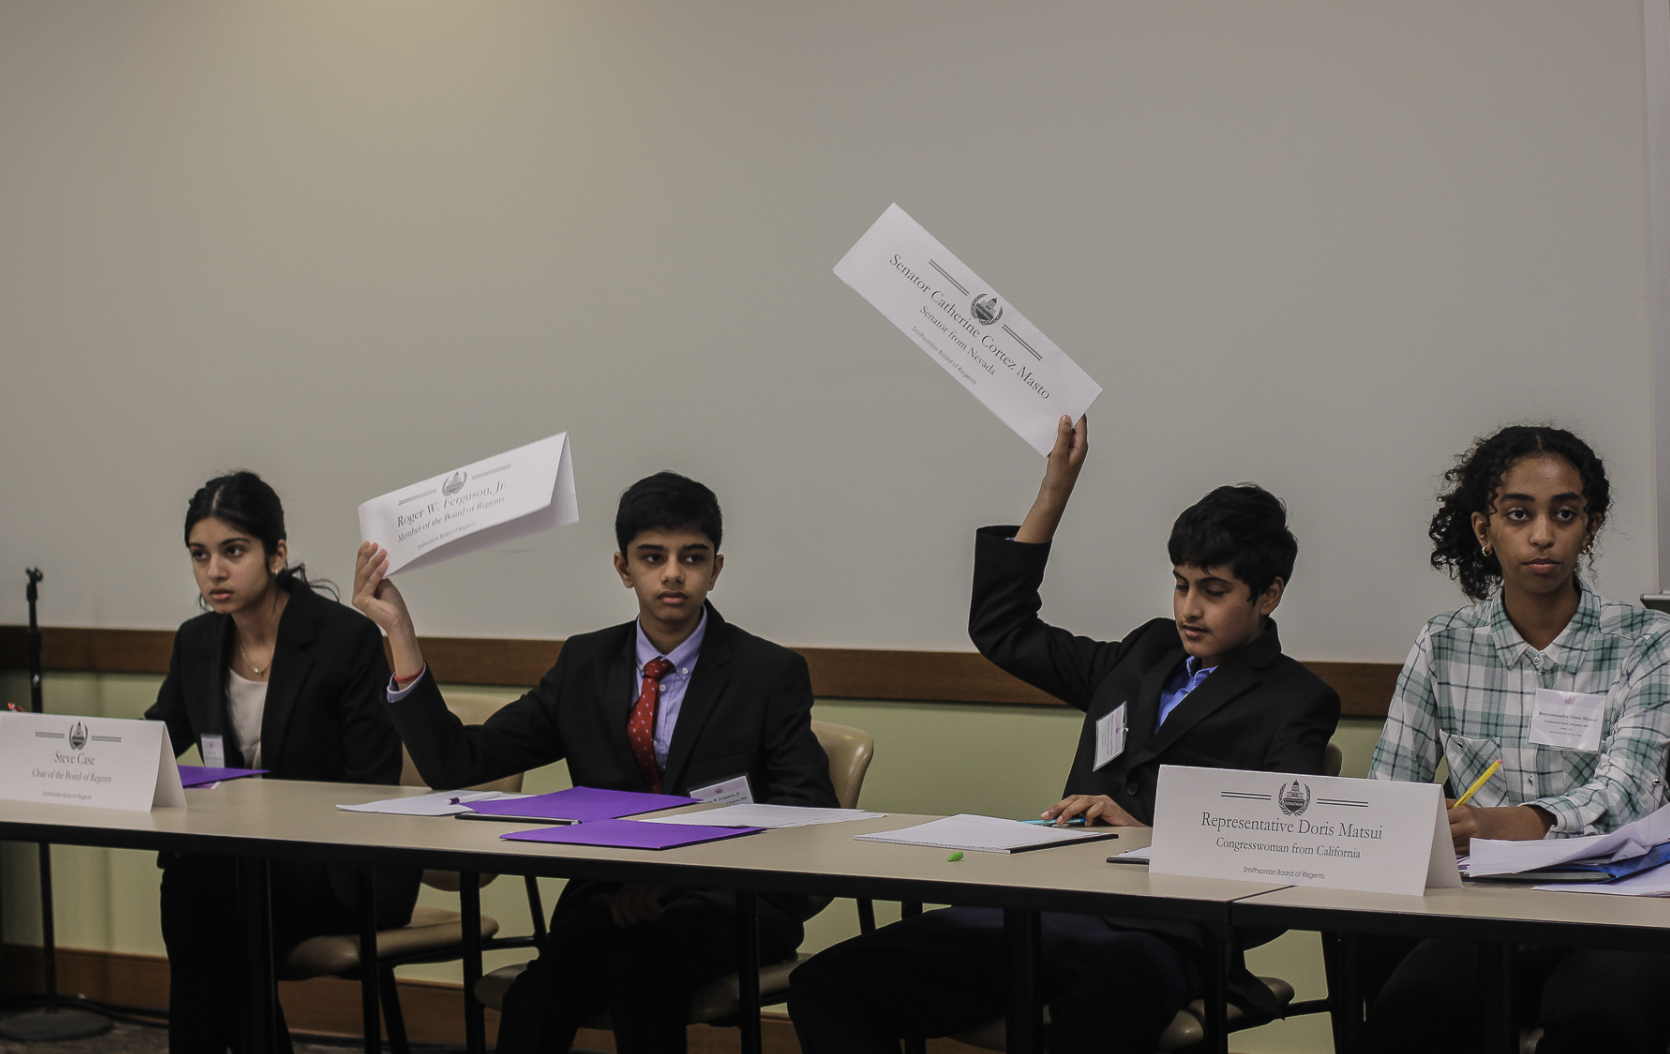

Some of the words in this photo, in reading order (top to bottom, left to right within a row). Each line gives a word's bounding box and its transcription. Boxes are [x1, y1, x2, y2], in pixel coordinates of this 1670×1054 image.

[889, 253, 931, 294] Senator
[931, 290, 980, 338] Catherine
[981, 335, 1016, 371] Cortez
[1017, 366, 1050, 400] Masto
[920, 305, 948, 334] Senator
[948, 330, 967, 351] from
[967, 346, 996, 375] Nevada
[912, 326, 940, 352] Smithsonian
[938, 349, 954, 364] Board
[951, 361, 959, 369] of
[957, 366, 977, 385] Regents
[397, 508, 424, 527] Roger
[427, 502, 438, 514] W.
[443, 488, 492, 508] Ferguson,
[495, 482, 507, 495] Jr.
[398, 526, 422, 542] Member
[423, 522, 431, 531] of
[432, 516, 442, 525] the
[444, 511, 465, 522] Board
[477, 497, 505, 510] Regents
[54, 751, 75, 764] Steve
[77, 752, 95, 765] Case
[32, 769, 47, 778] Chair
[48, 769, 55, 778] of
[65, 772, 82, 781] Board
[83, 772, 90, 782] of
[91, 773, 111, 784] Regents
[1201, 812, 1294, 834] Representative
[1298, 819, 1334, 836] Doris
[1338, 823, 1382, 839] Matsui
[1216, 837, 1289, 853] Congresswoman
[1292, 843, 1314, 855] from
[1316, 845, 1361, 858] California
[1243, 866, 1276, 875] Smithsonian
[1277, 869, 1293, 877] Board
[1302, 871, 1325, 879] Regents
